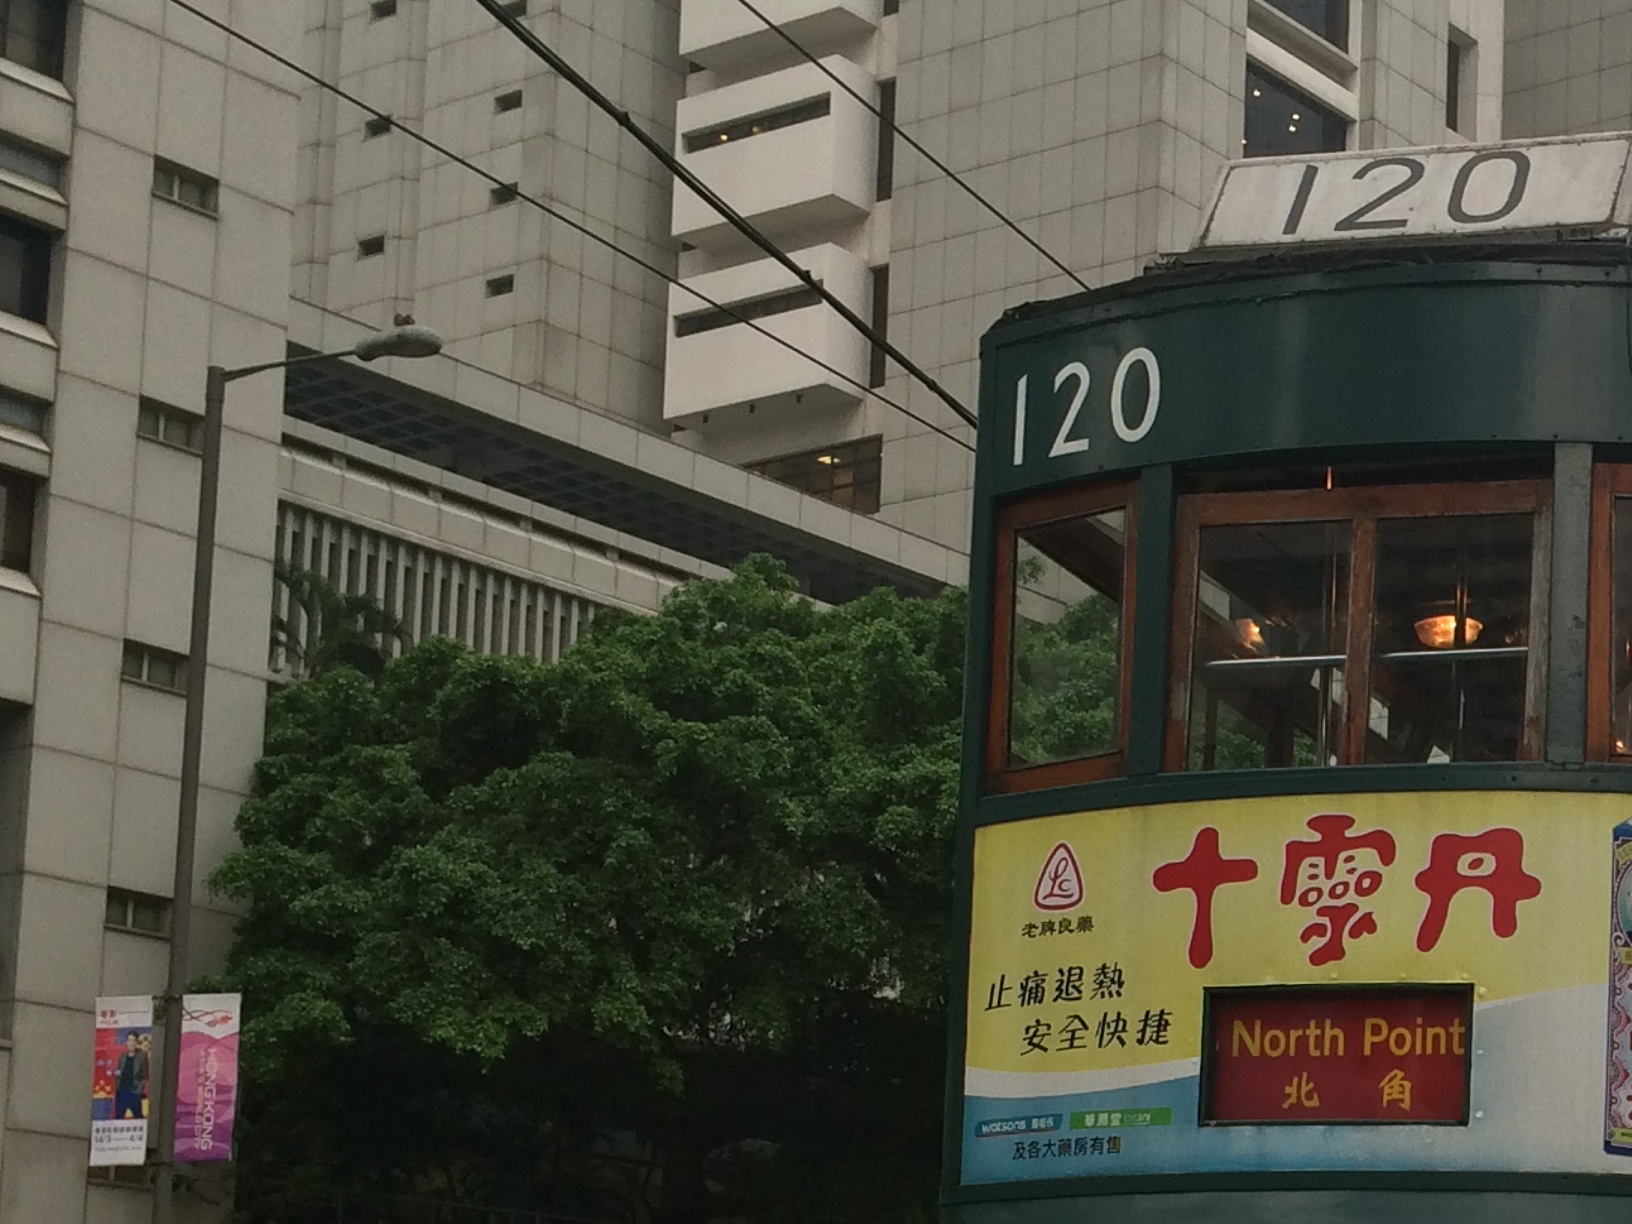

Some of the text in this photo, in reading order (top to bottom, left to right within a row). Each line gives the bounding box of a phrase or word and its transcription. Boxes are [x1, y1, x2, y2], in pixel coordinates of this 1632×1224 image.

[1282, 149, 1532, 236] 120
[1011, 347, 1162, 467] 120
[984, 962, 1125, 1012] 止痛退熱
[1019, 1008, 1173, 1056] 安全快捷
[1231, 1017, 1466, 1058] North Point
[200, 1100, 216, 1150] KONG
[1012, 1135, 1123, 1161] 及各大藥房有售
